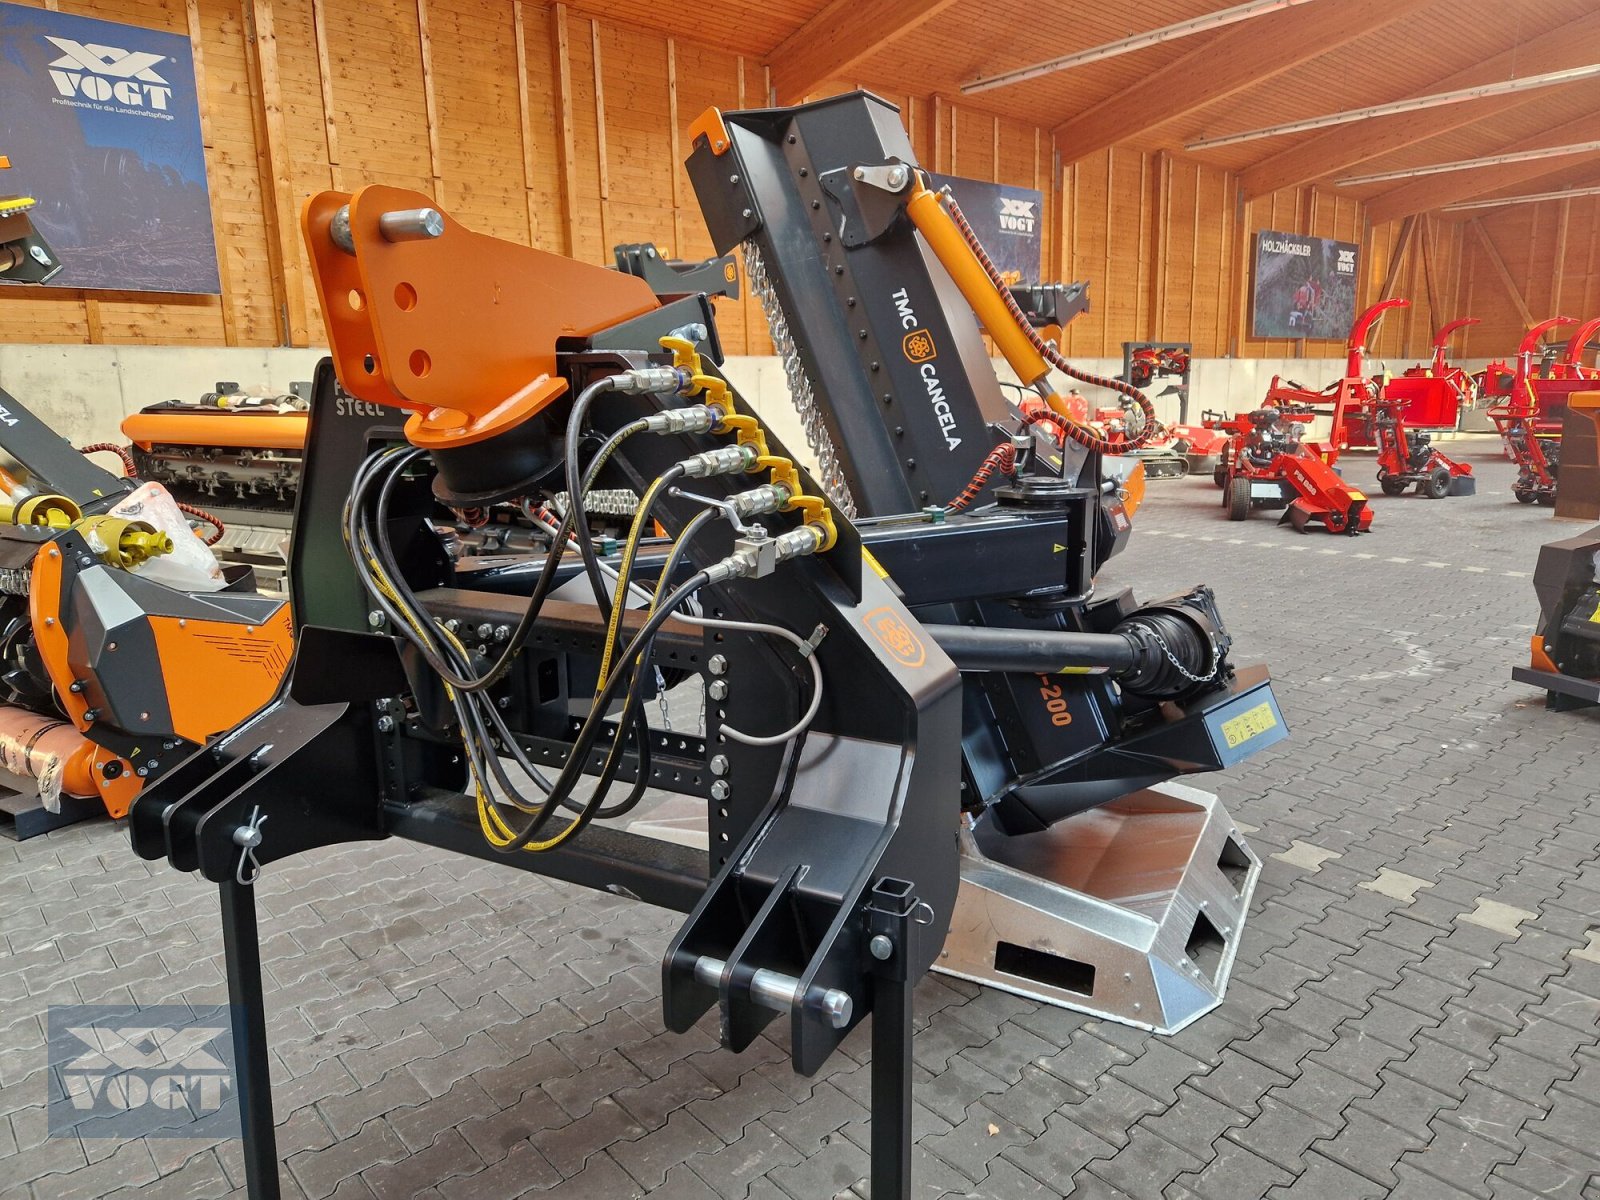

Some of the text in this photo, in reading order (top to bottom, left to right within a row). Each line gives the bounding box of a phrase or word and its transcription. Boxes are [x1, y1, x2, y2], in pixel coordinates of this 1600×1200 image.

[48, 69, 172, 111] VOGT
[51, 97, 175, 121] Profitechnik für die Landschaftspflege
[1000, 215, 1034, 232] VOGT
[1262, 239, 1311, 257] HOLZHÄCKSLER
[1337, 261, 1355, 273] VOGT
[892, 287, 918, 330] TMC
[335, 397, 385, 417] STEEL
[920, 363, 962, 451] CANCELA
[1034, 671, 1073, 727] -200
